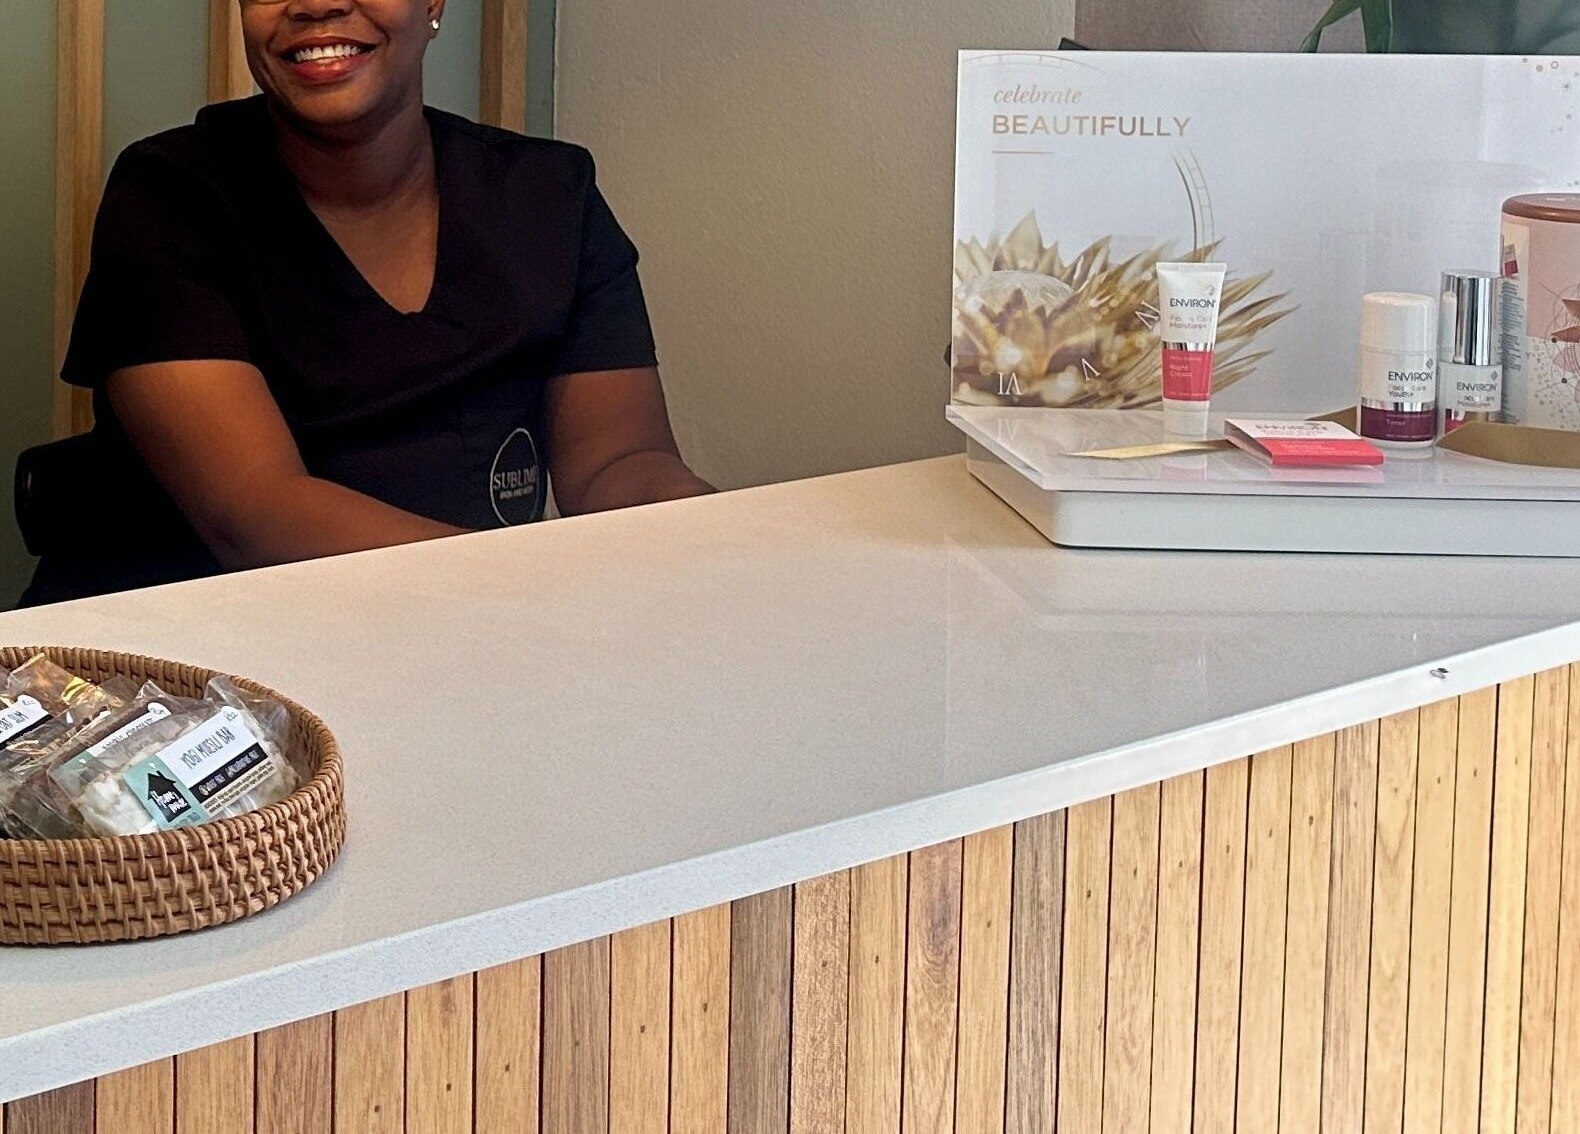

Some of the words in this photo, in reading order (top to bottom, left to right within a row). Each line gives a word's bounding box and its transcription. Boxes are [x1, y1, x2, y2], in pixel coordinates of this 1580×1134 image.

[993, 84, 1083, 105] celebrate
[992, 114, 1191, 137] BEAUTIFULLY
[1169, 297, 1215, 308] ENVIRON
[1388, 371, 1434, 382] ENVIRON
[180, 749, 200, 770] YOGI
[195, 732, 224, 758] MUESLI
[217, 725, 236, 745] BAR
